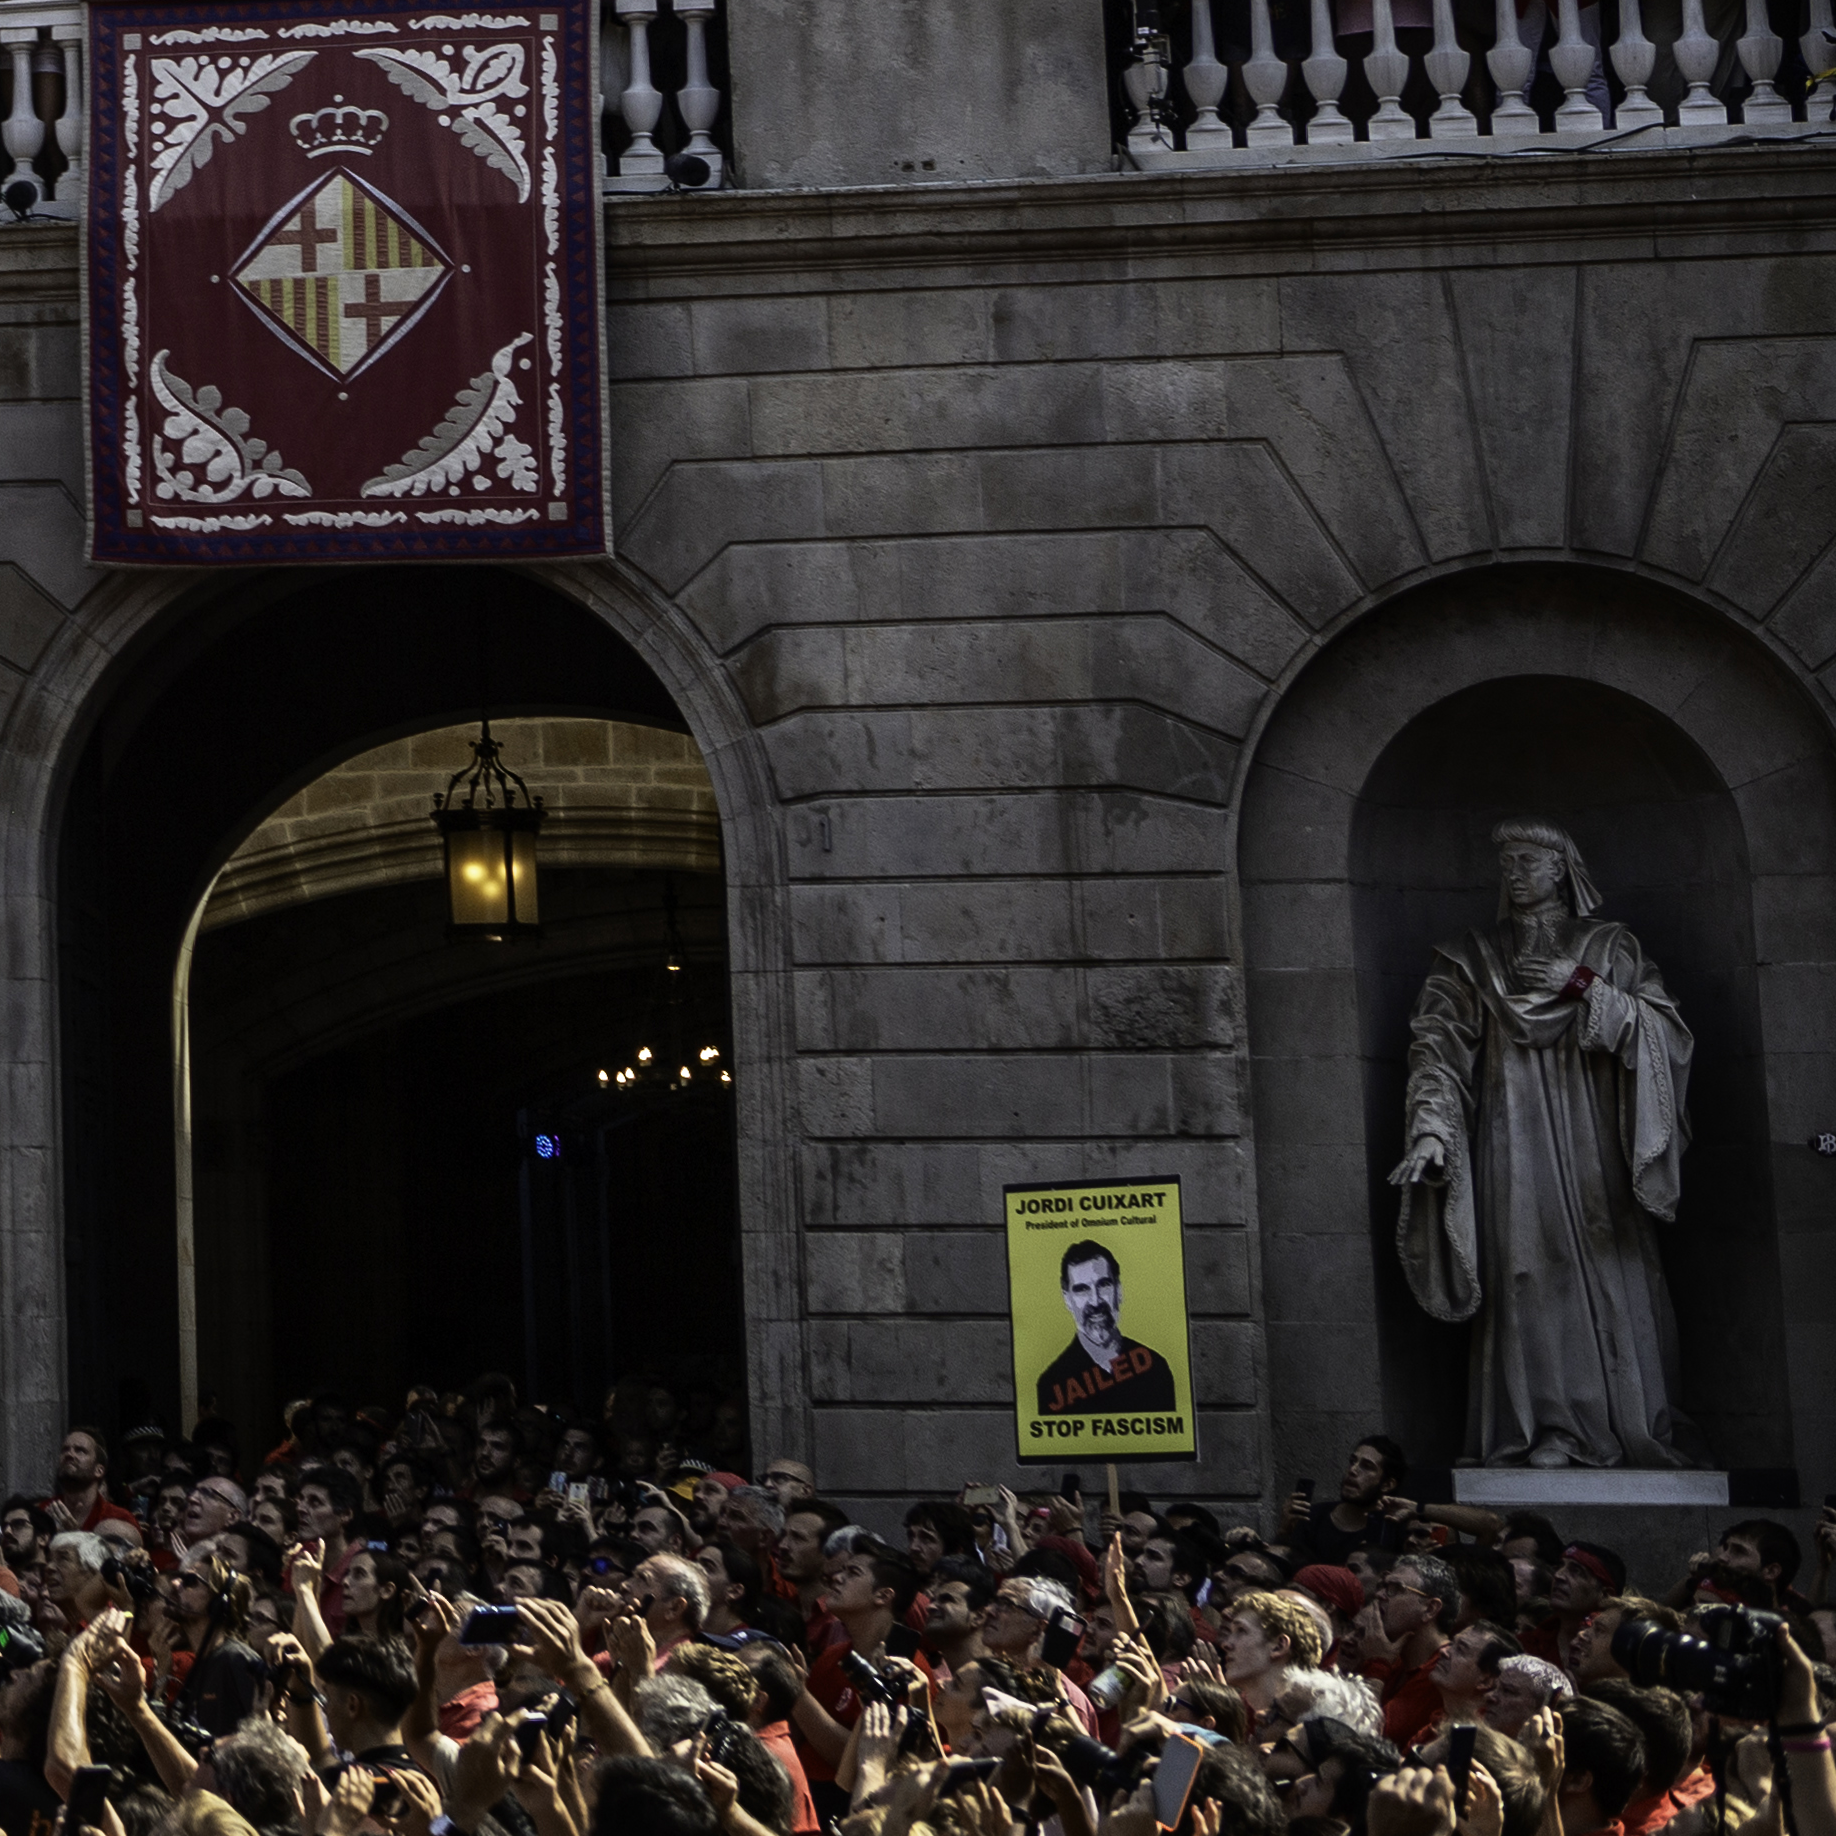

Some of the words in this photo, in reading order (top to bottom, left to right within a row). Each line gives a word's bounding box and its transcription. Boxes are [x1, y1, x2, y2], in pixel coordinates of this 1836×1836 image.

[1015, 1196, 1074, 1215] JORDI
[1079, 1192, 1166, 1212] CUIXART
[1025, 1219, 1068, 1231] President
[1071, 1218, 1079, 1228] of
[1120, 1214, 1157, 1225] Cultural
[1047, 1346, 1153, 1412] JAILED
[1030, 1420, 1085, 1439] STOP
[1091, 1416, 1184, 1436] FASCISM
